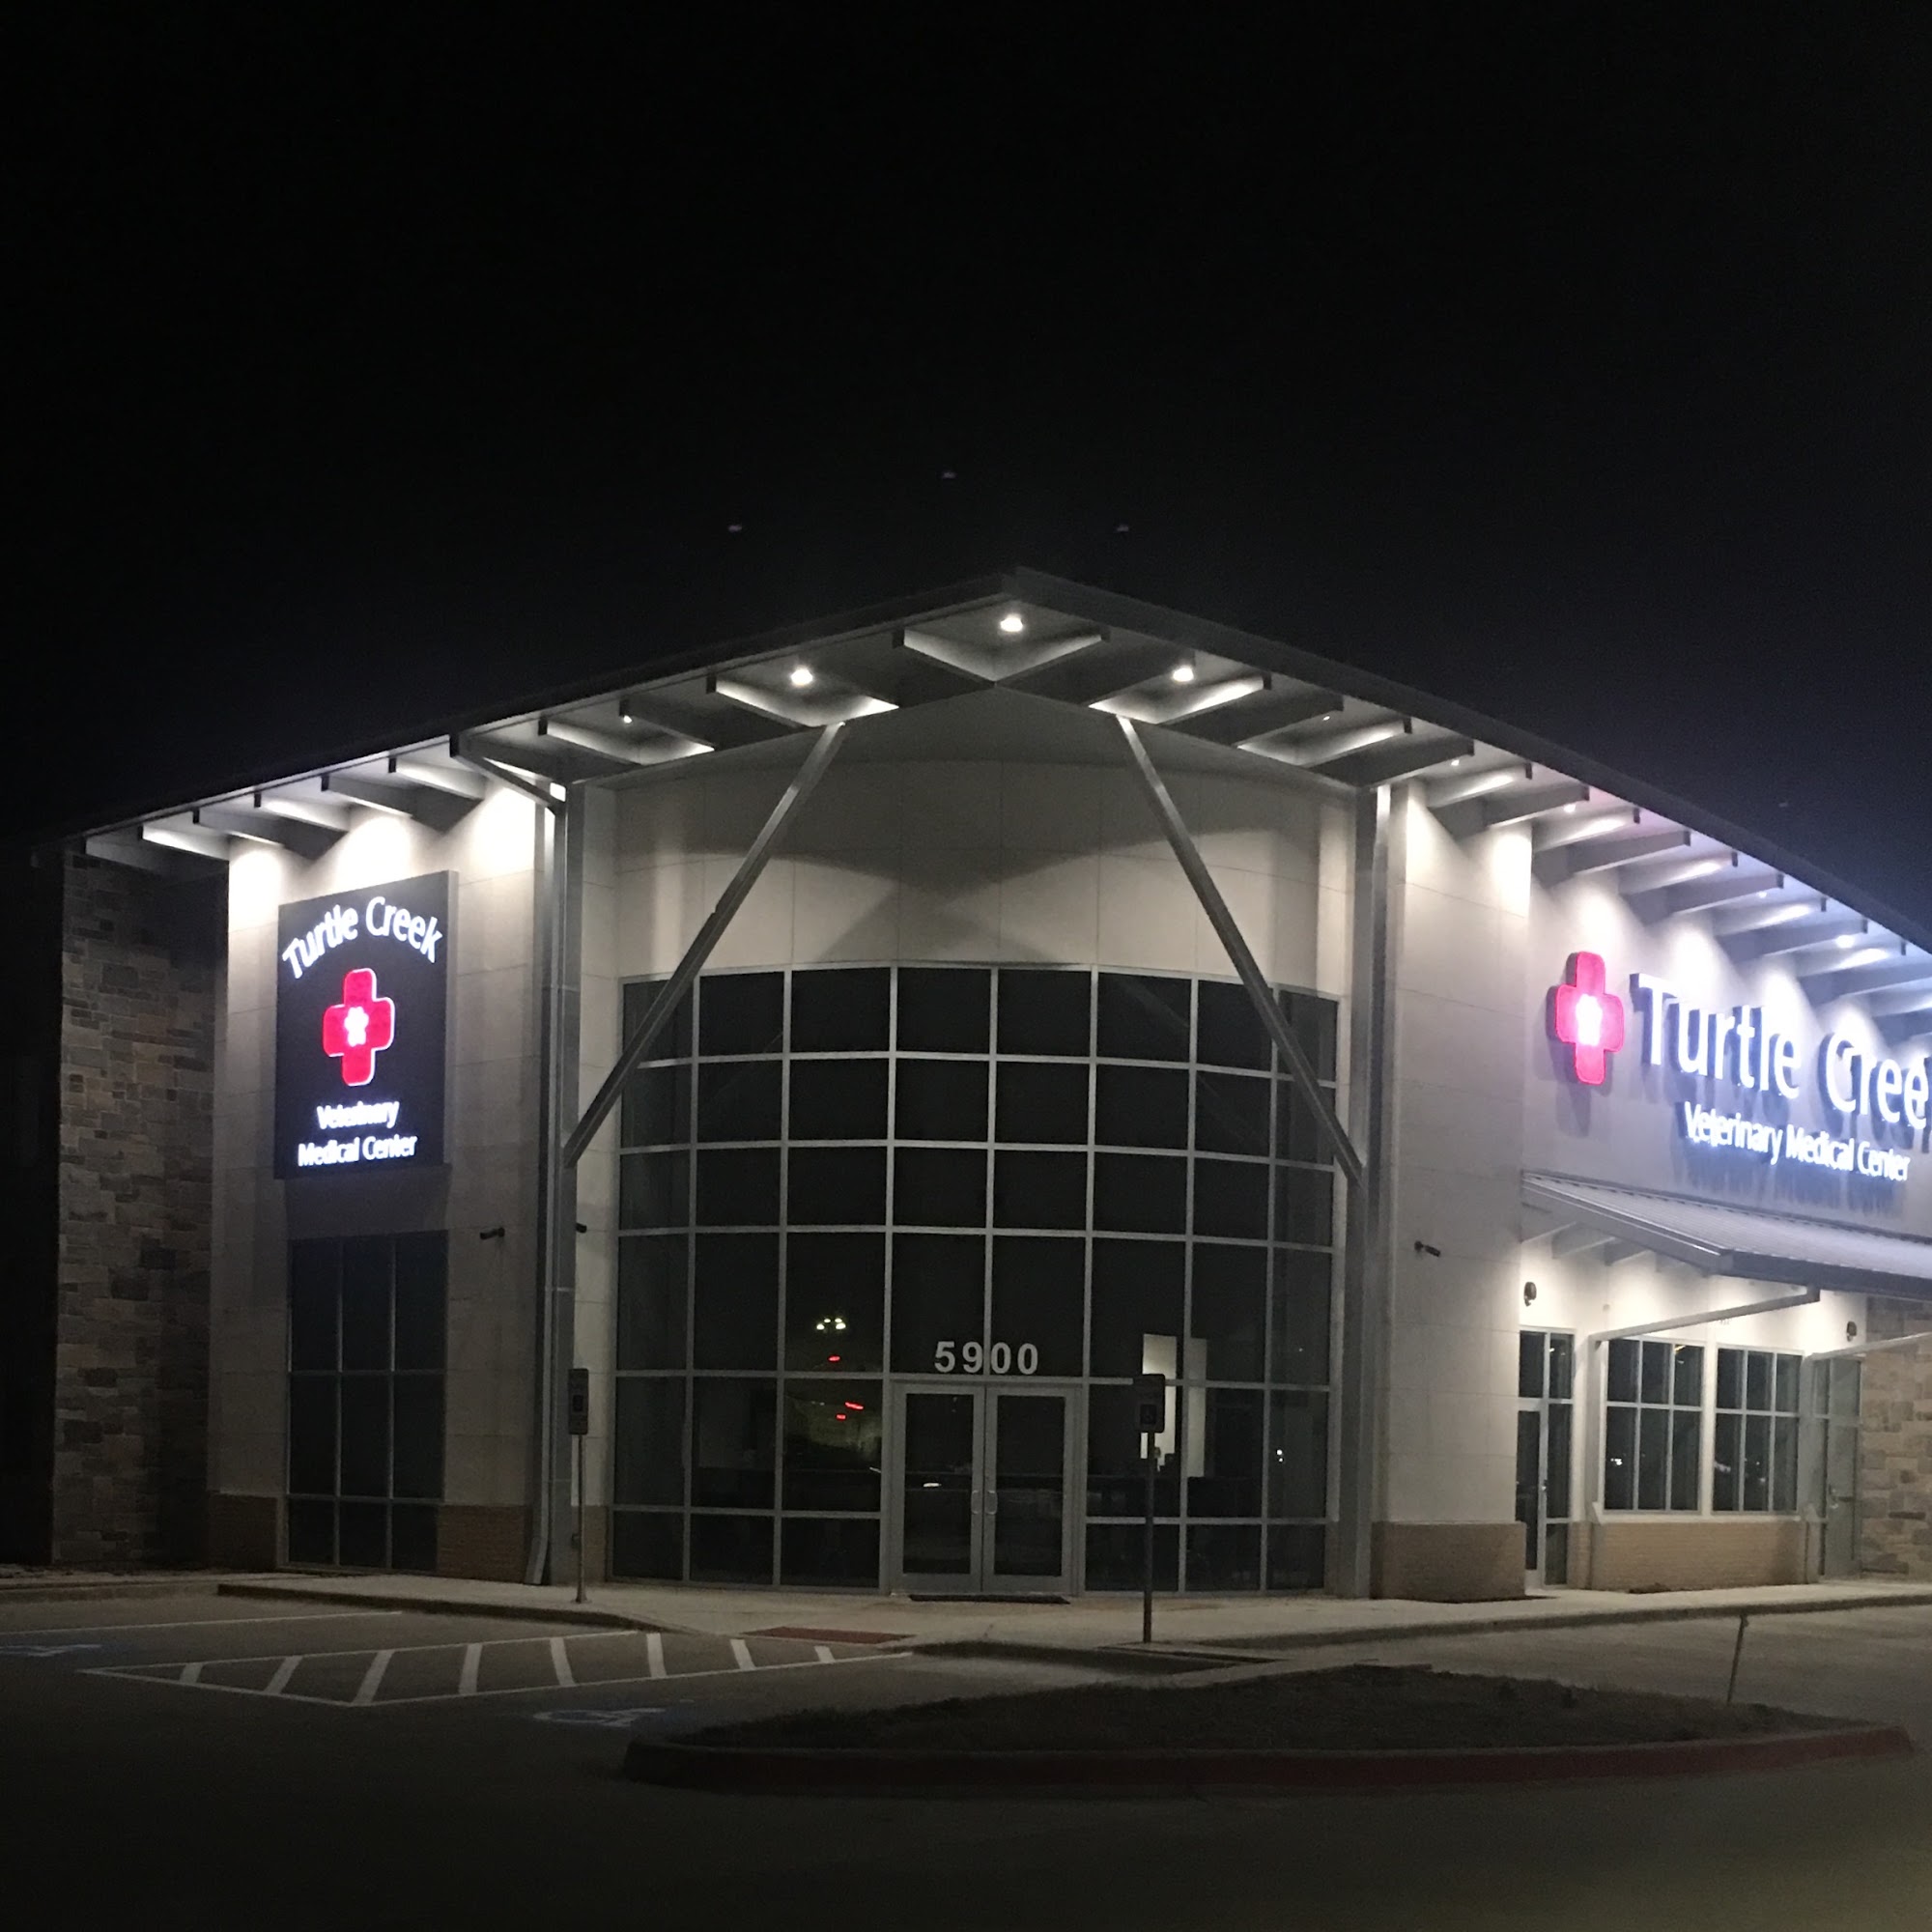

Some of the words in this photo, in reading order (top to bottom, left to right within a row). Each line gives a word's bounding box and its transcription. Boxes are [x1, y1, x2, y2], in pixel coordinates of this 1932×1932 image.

[281, 904, 358, 979] Turtle
[365, 896, 443, 963] Creek
[1637, 973, 1803, 1099] Turtle
[316, 1100, 400, 1129] Veterinary
[1685, 1100, 1783, 1165] Veterinary
[1785, 1123, 1855, 1171] Medical
[1857, 1141, 1912, 1181] Center
[298, 1136, 360, 1166] Medical
[362, 1134, 417, 1160] Center
[934, 1341, 1038, 1375] 5900
